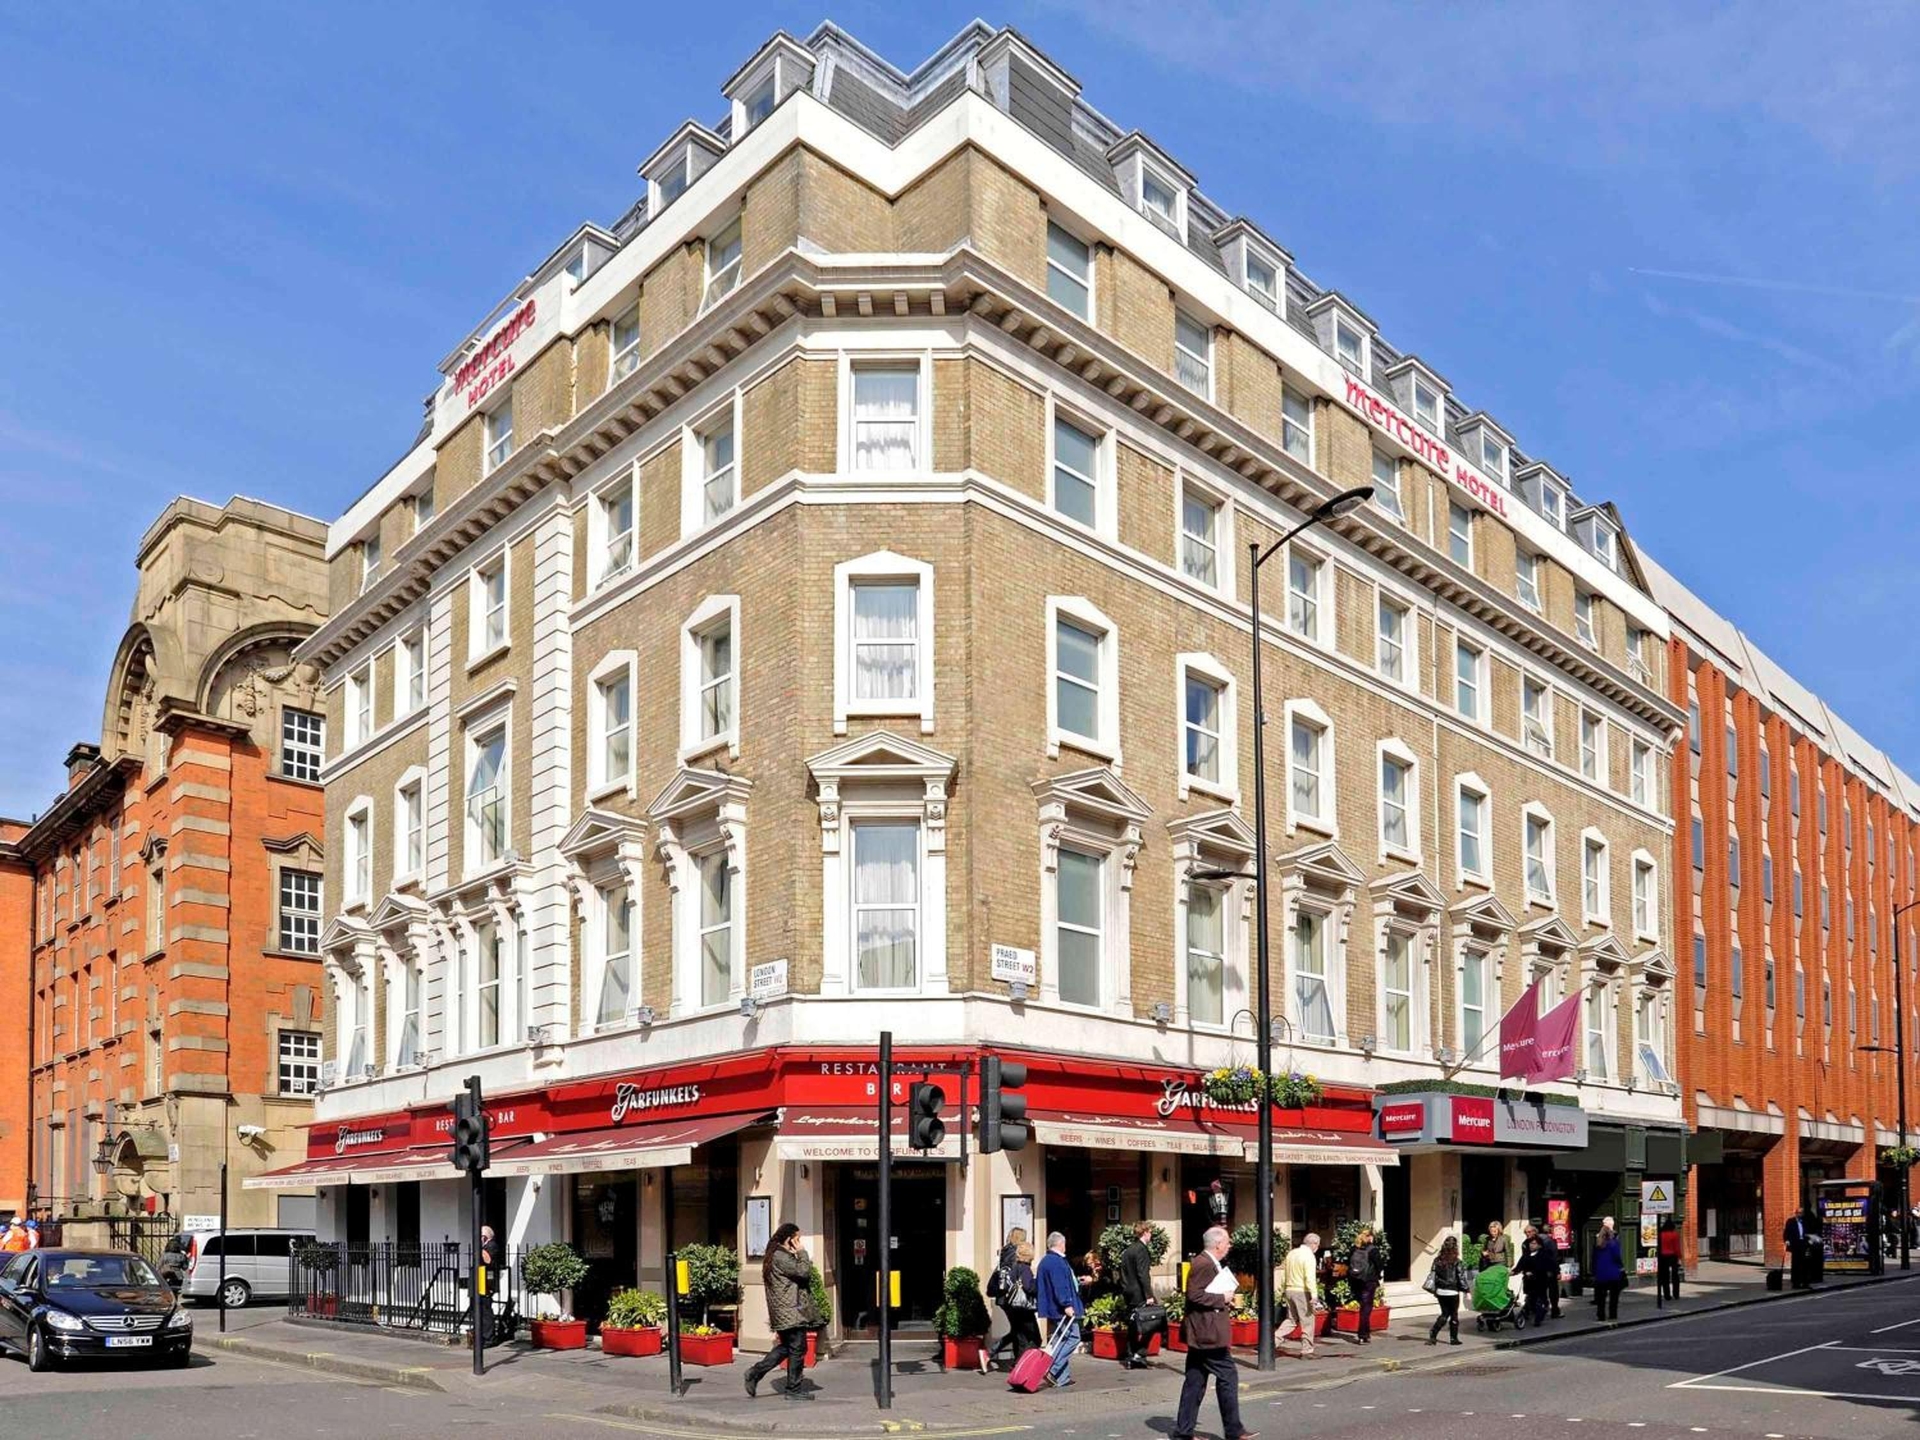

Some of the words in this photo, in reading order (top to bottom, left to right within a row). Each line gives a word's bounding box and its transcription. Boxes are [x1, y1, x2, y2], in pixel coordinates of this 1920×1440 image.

[468, 354, 515, 409] HOTEL
[1456, 465, 1508, 518] HOTEL
[996, 948, 1018, 960] PRAED
[996, 959, 1020, 971] STREET
[1022, 963, 1034, 974] W2
[753, 976, 772, 989] STREET
[866, 1083, 902, 1095] BR
[498, 1111, 514, 1123] BAR
[1386, 1113, 1416, 1122] Mercure
[1458, 1115, 1490, 1127] Mercure
[1507, 1119, 1537, 1130] LONDON
[1060, 1133, 1083, 1143] BEERS
[1095, 1135, 1116, 1145] WINES
[1127, 1137, 1156, 1147] COFFEES
[803, 1147, 854, 1157] WELCOME
[858, 1147, 871, 1156] TO
